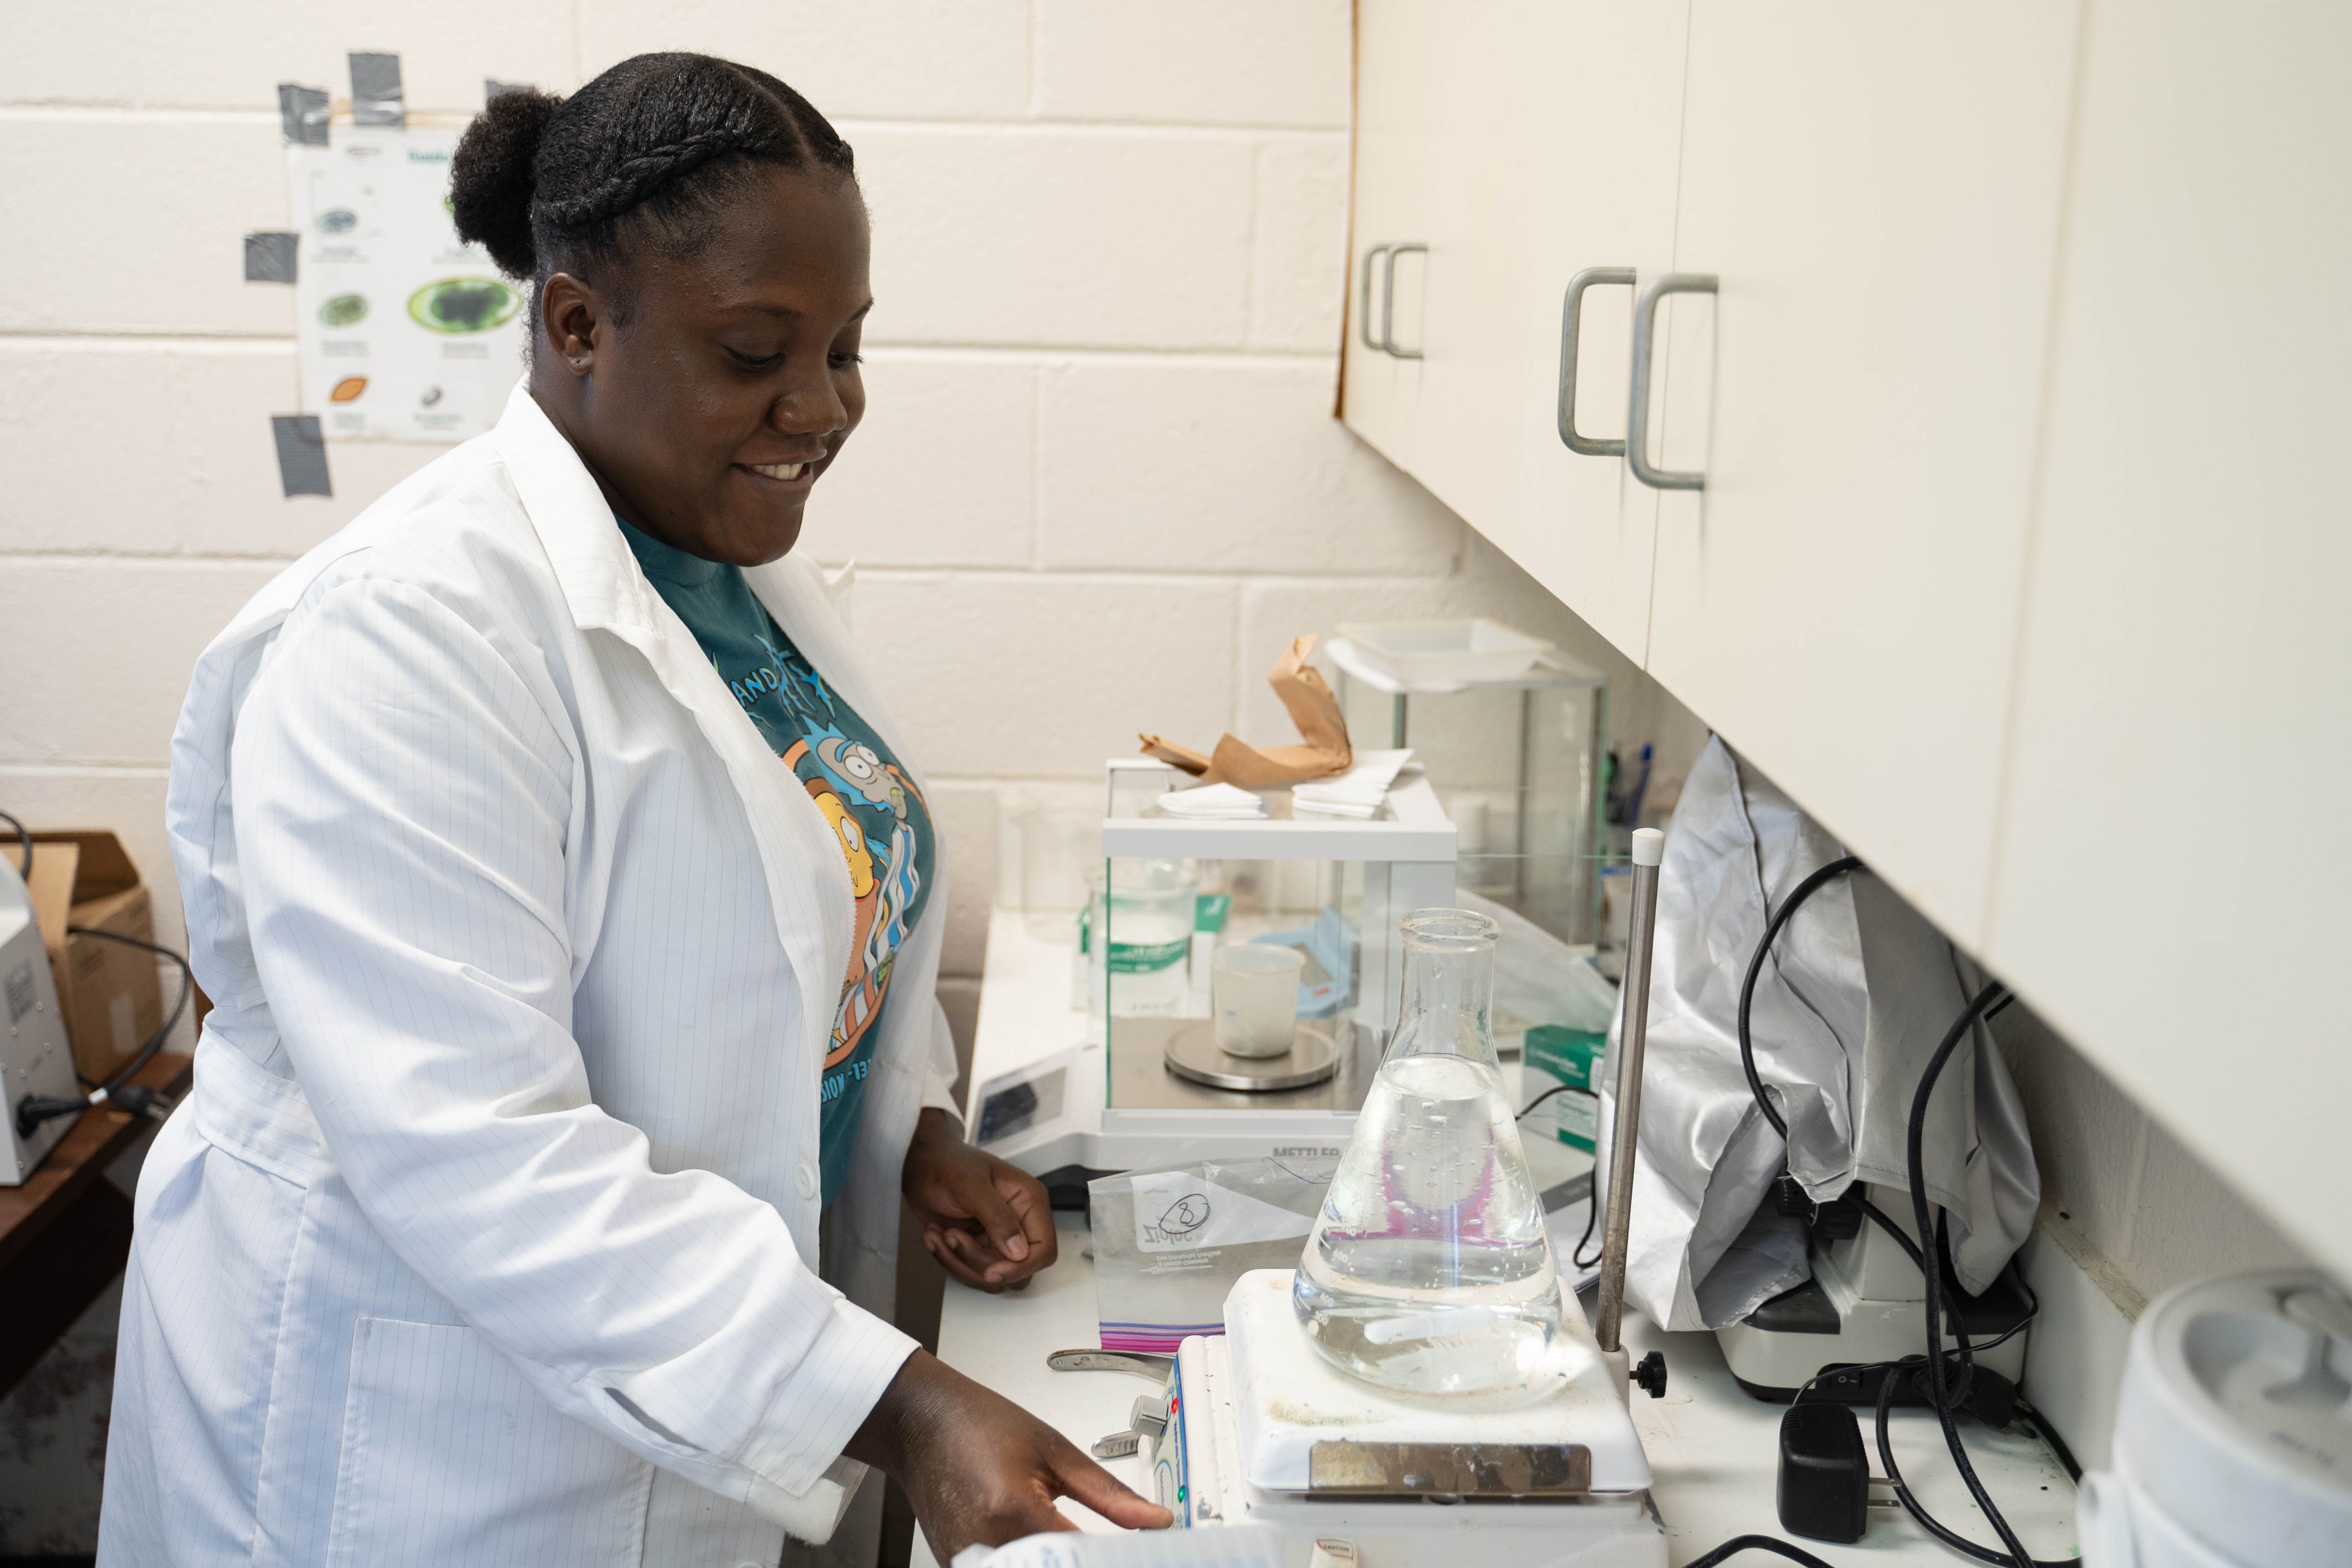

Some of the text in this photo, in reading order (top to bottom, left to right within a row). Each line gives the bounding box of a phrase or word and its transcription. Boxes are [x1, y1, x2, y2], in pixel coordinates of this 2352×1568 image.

[730, 667, 778, 708] AND
[1332, 1248, 1348, 1263] 600
[1320, 1292, 1334, 1307] 400
